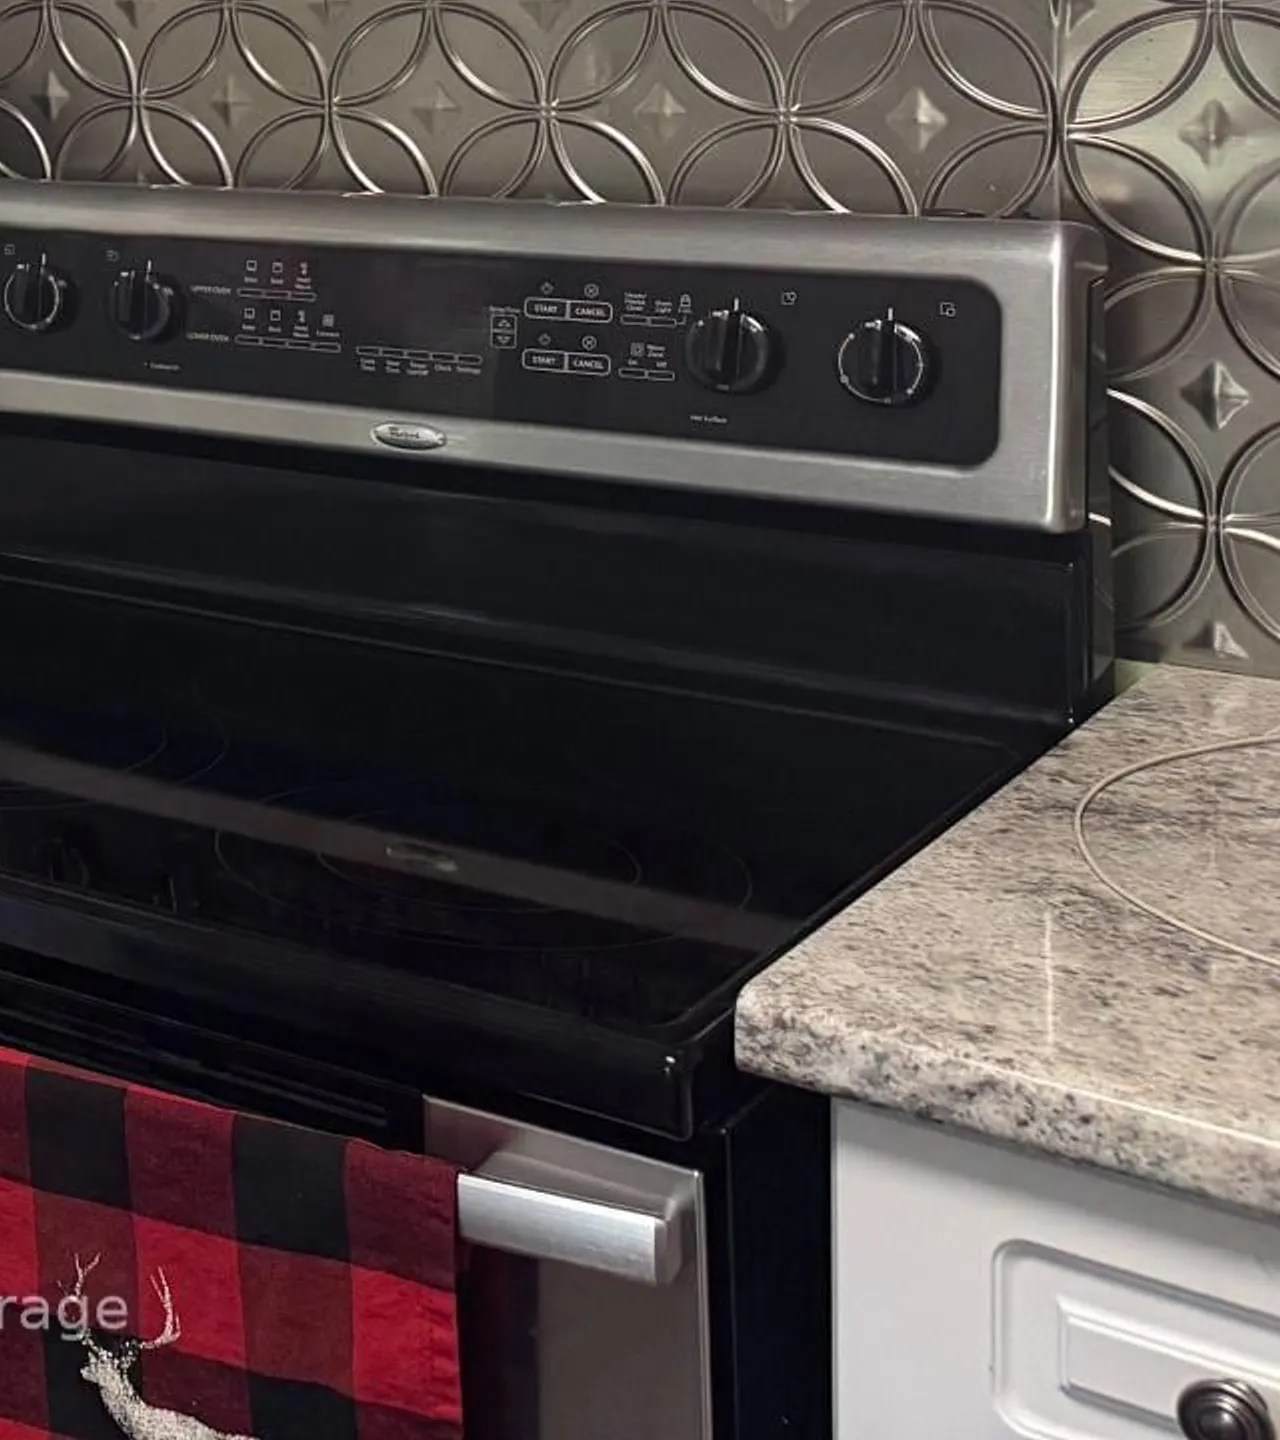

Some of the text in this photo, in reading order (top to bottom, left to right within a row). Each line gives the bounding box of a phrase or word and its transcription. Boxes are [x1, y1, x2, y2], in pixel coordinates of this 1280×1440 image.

[533, 304, 606, 318] START CANCEL
[531, 355, 605, 370] START CANCEL
